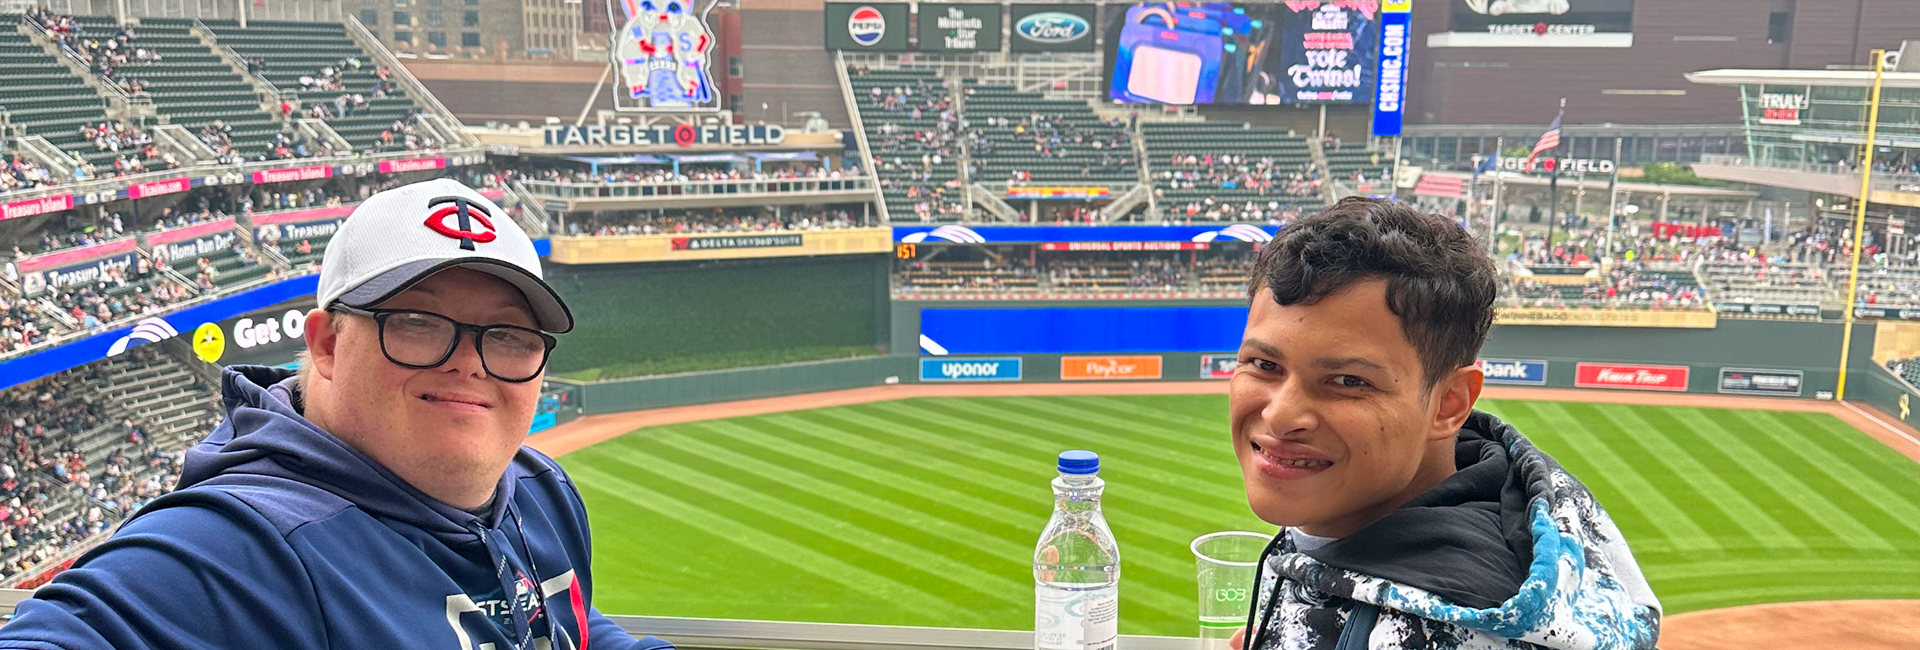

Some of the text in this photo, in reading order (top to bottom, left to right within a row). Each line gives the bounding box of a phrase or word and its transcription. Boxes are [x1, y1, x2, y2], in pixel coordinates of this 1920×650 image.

[948, 7, 964, 19] The
[937, 16, 982, 29] Minnesota
[1029, 17, 1076, 39] Ford
[1487, 24, 1596, 35] TARGET CENTER
[944, 36, 976, 49] Tribune
[957, 29, 977, 40] Star
[1379, 24, 1405, 113] CHSINC.COM
[1762, 93, 1804, 109] TRULY
[547, 124, 786, 147] TARGET FIELD
[1471, 155, 1615, 173] TRGET FIELD
[262, 170, 299, 183] Treasure
[300, 166, 326, 180] Island
[2, 202, 42, 219] Treasure
[42, 197, 67, 215] Island
[285, 220, 335, 239] Treasure
[169, 242, 197, 261] Home
[196, 237, 215, 254] Run
[700, 238, 736, 249] DELTA
[48, 266, 99, 288] Treasure
[234, 309, 307, 349] Get O
[942, 362, 999, 379] uponor
[1086, 358, 1137, 378] Paycor
[1481, 360, 1528, 378] bank
